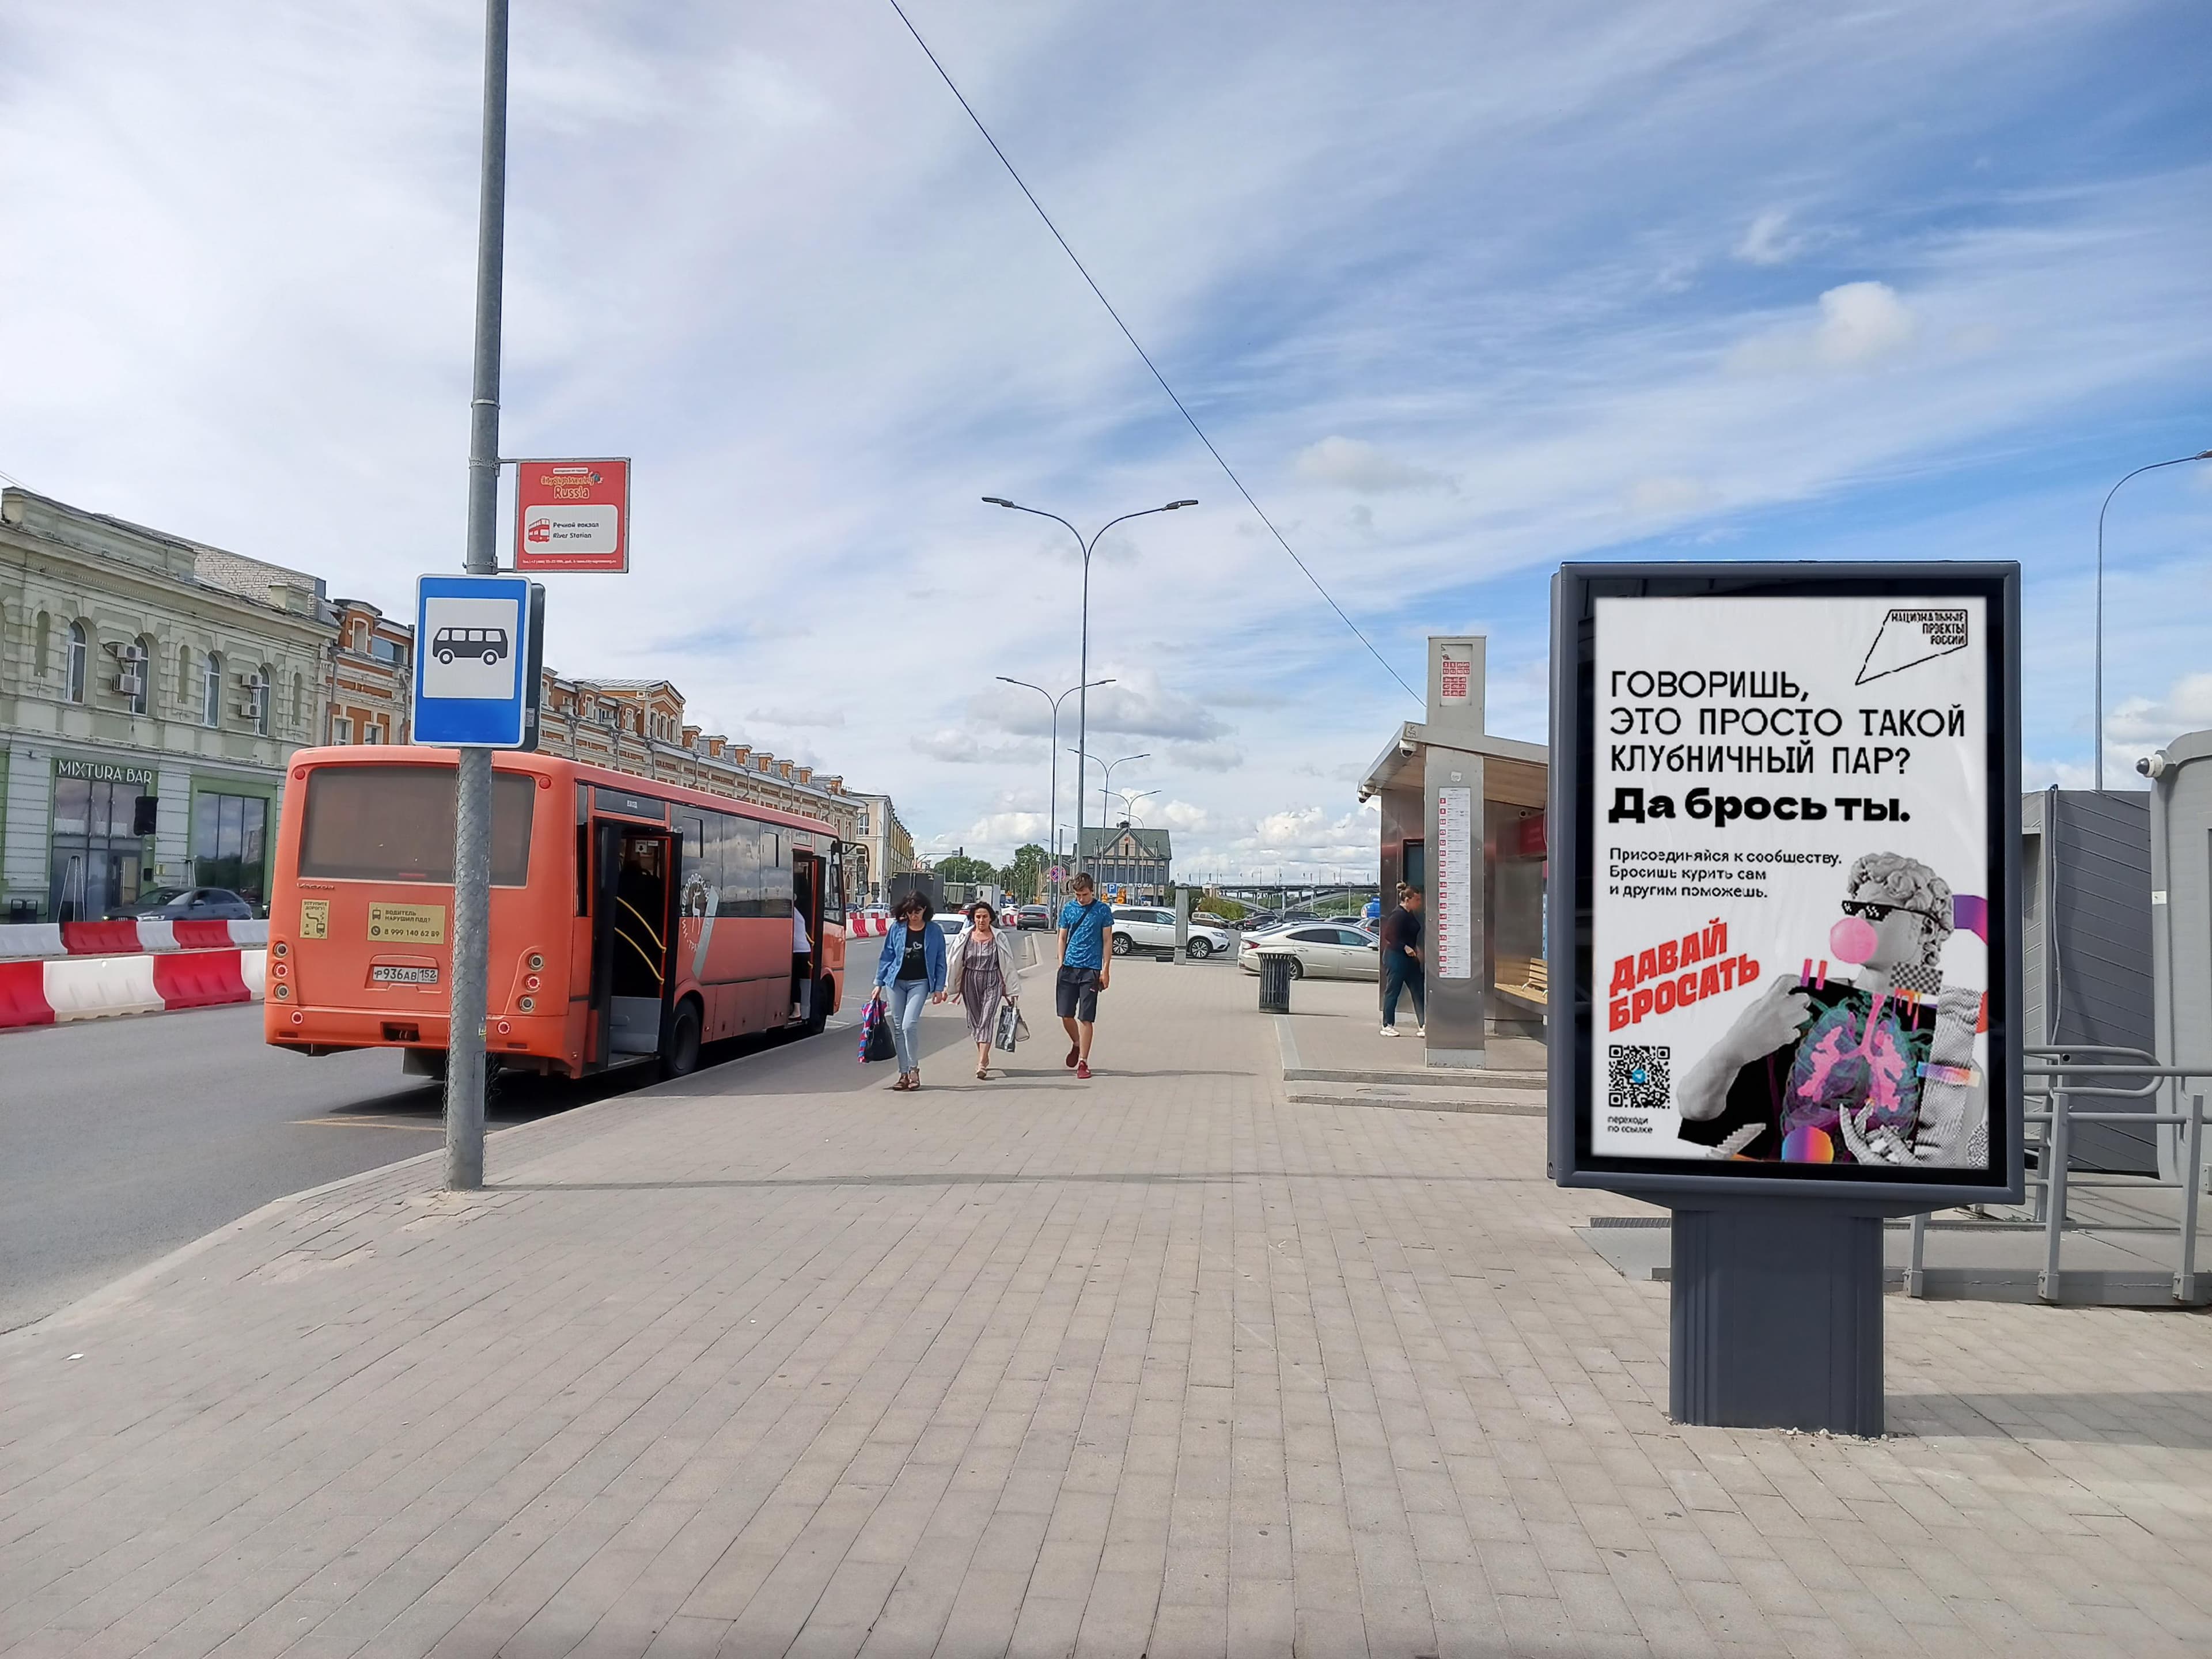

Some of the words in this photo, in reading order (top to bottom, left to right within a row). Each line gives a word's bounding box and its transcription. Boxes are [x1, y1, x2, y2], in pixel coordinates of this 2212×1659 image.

[554, 486, 589, 499] Russia
[1922, 623, 1965, 634] ПРОЕКТЫ
[1930, 635, 1965, 645] РОССИИ
[1612, 671, 1809, 702] ГОВОРИШЬ,
[1610, 707, 1681, 735] ЭТО
[1699, 707, 1843, 736] ПРОСТО
[1858, 703, 1965, 737] ТАКОЙ
[1832, 746, 1911, 775] ПАР?
[58, 759, 122, 781] MIXTURA
[126, 768, 152, 785] BAR
[1608, 787, 1676, 824] Да
[1684, 787, 1828, 828] брось
[1834, 797, 1911, 823] ты.
[1609, 847, 1729, 863] Присоединяйся
[1734, 853, 1744, 862] к
[1609, 865, 1677, 881] Бросишь
[1681, 869, 1733, 882] курить
[1737, 870, 1766, 880] сам
[1609, 885, 1619, 895] и
[1622, 885, 1677, 900] другим
[1681, 887, 1768, 898] поможешь.
[1609, 917, 1727, 998] ДАВАЙ
[419, 969, 436, 979] 152
[1609, 954, 1760, 1032] БРОСАТЬ
